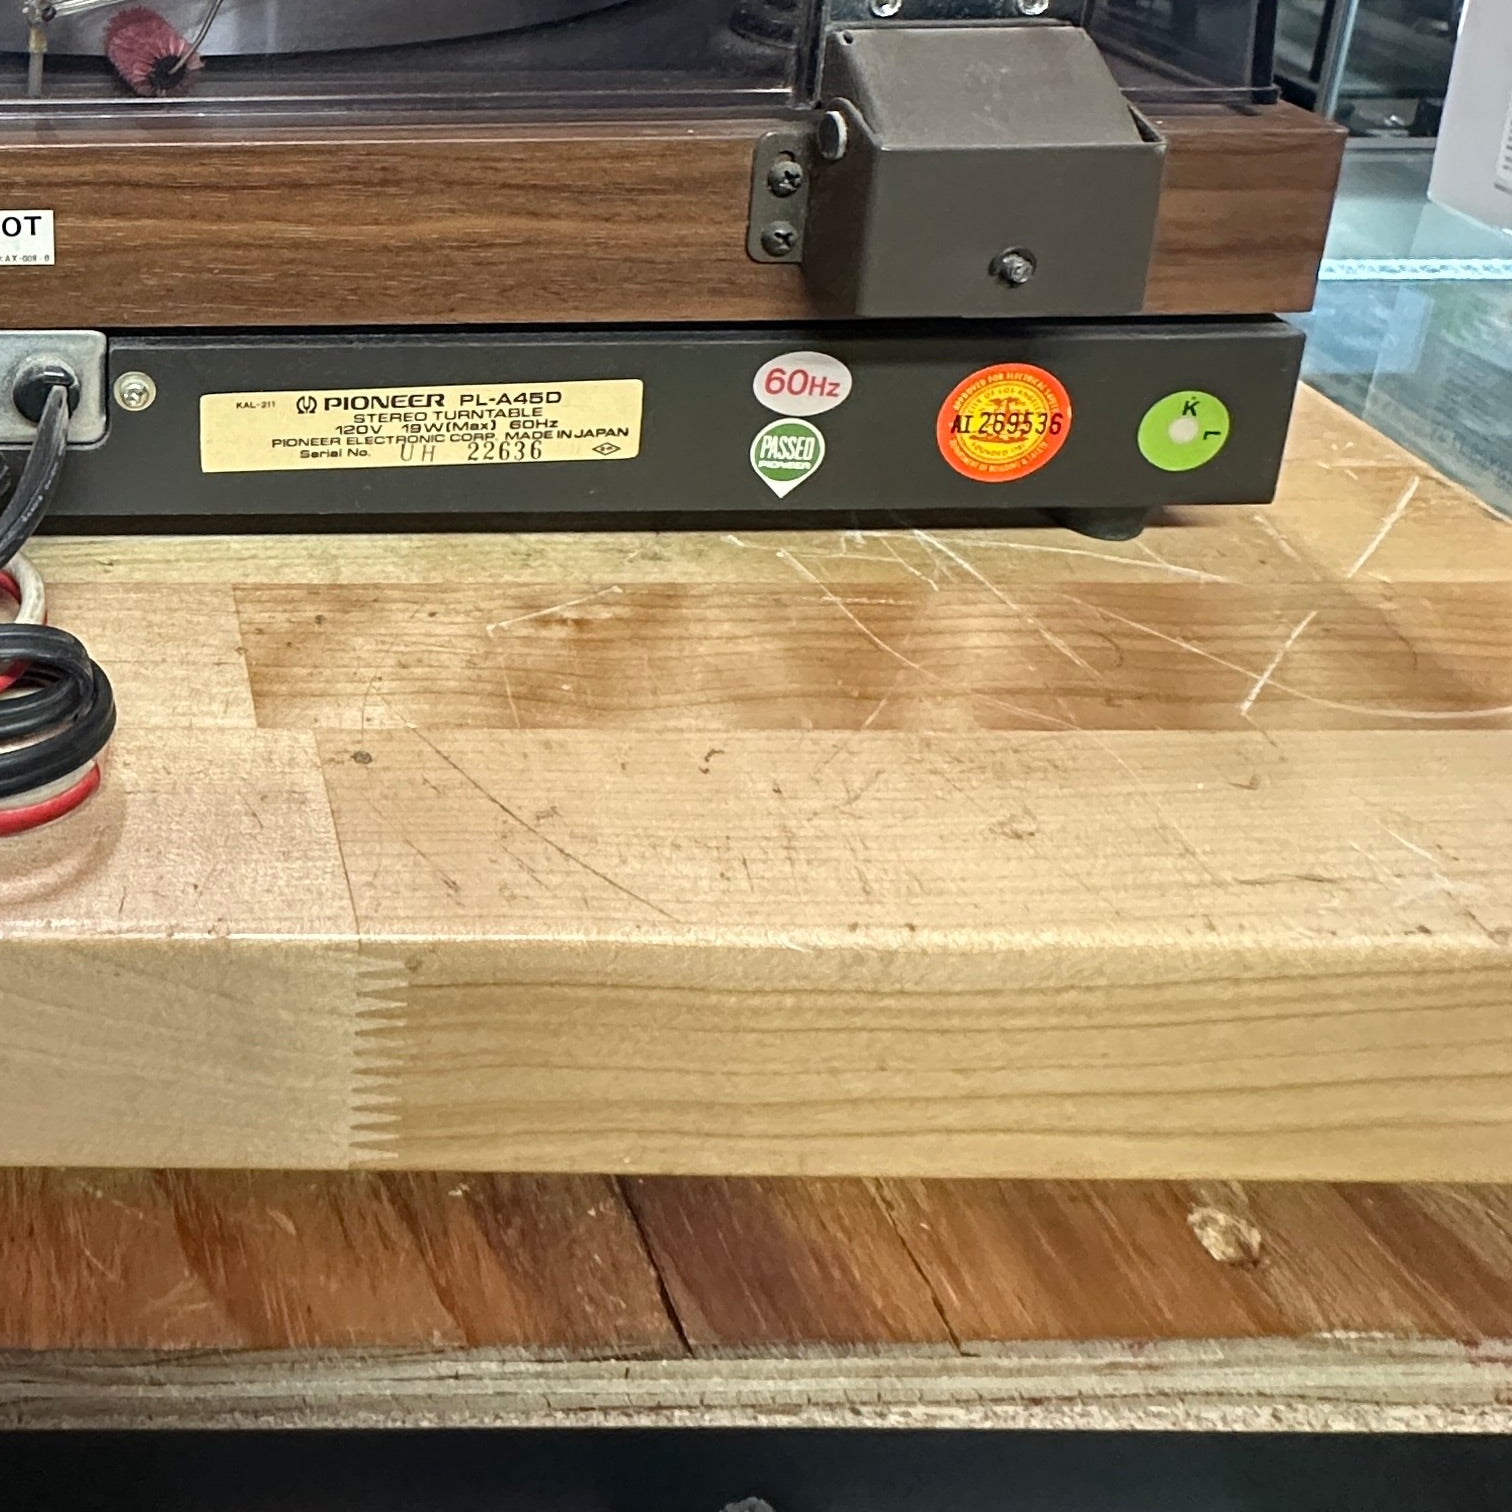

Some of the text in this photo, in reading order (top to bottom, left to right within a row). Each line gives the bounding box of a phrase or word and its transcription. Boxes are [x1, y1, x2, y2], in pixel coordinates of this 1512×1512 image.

[765, 368, 840, 397] 60Hz
[236, 391, 562, 411] KAL-211 PIONEER PL-A45D
[1182, 400, 1200, 416] K
[353, 407, 543, 424] STEREO TURNTABLE
[978, 411, 1064, 435] 269536
[272, 437, 341, 448] PIONEER
[346, 433, 445, 446] ELECTRONIC
[505, 430, 554, 441] MADE
[557, 429, 573, 439] IN
[574, 427, 630, 438] JAPAN
[336, 424, 383, 435] 120V
[509, 419, 559, 430] 60Hz
[300, 449, 342, 459] Serial
[347, 448, 371, 458] No.
[467, 440, 542, 461] 22636
[760, 435, 815, 460] PASSED
